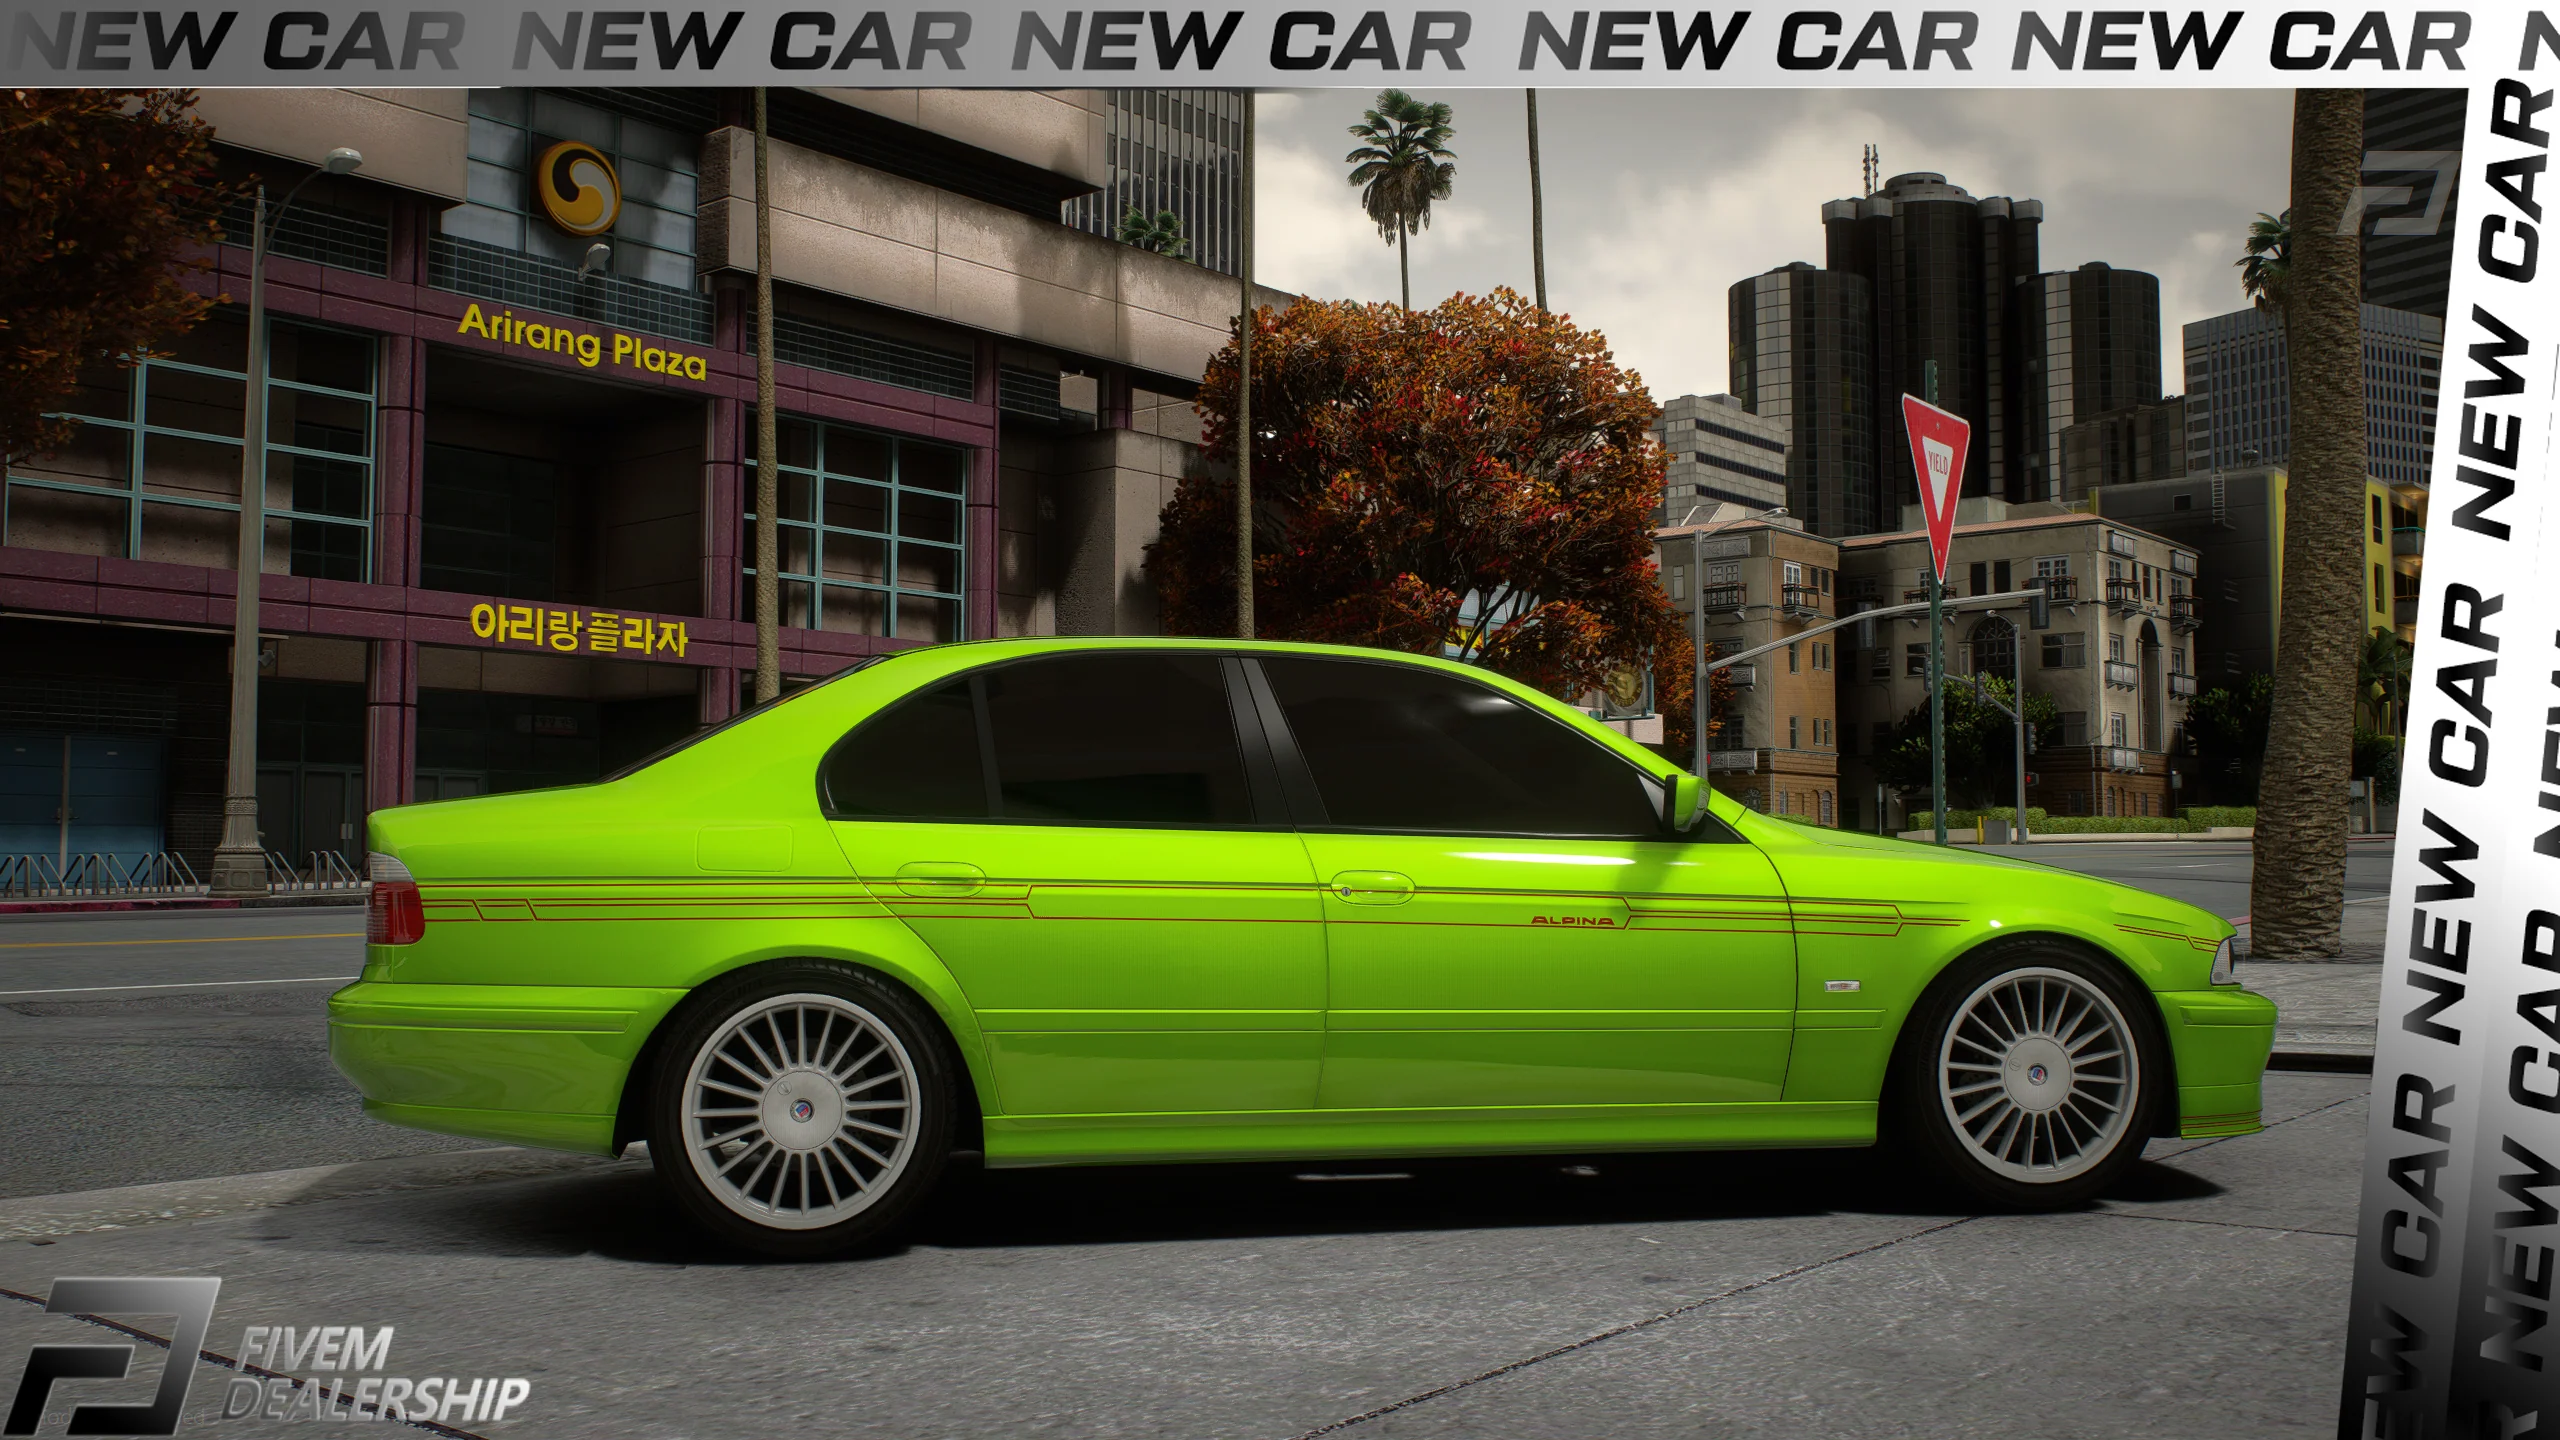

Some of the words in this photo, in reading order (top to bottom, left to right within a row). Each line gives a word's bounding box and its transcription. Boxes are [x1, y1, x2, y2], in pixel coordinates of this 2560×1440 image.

[457, 303, 600, 367] Arirang
[613, 333, 707, 381] Plaza
[1929, 452, 1948, 475] YIELD
[1532, 916, 1615, 925] ALPINA
